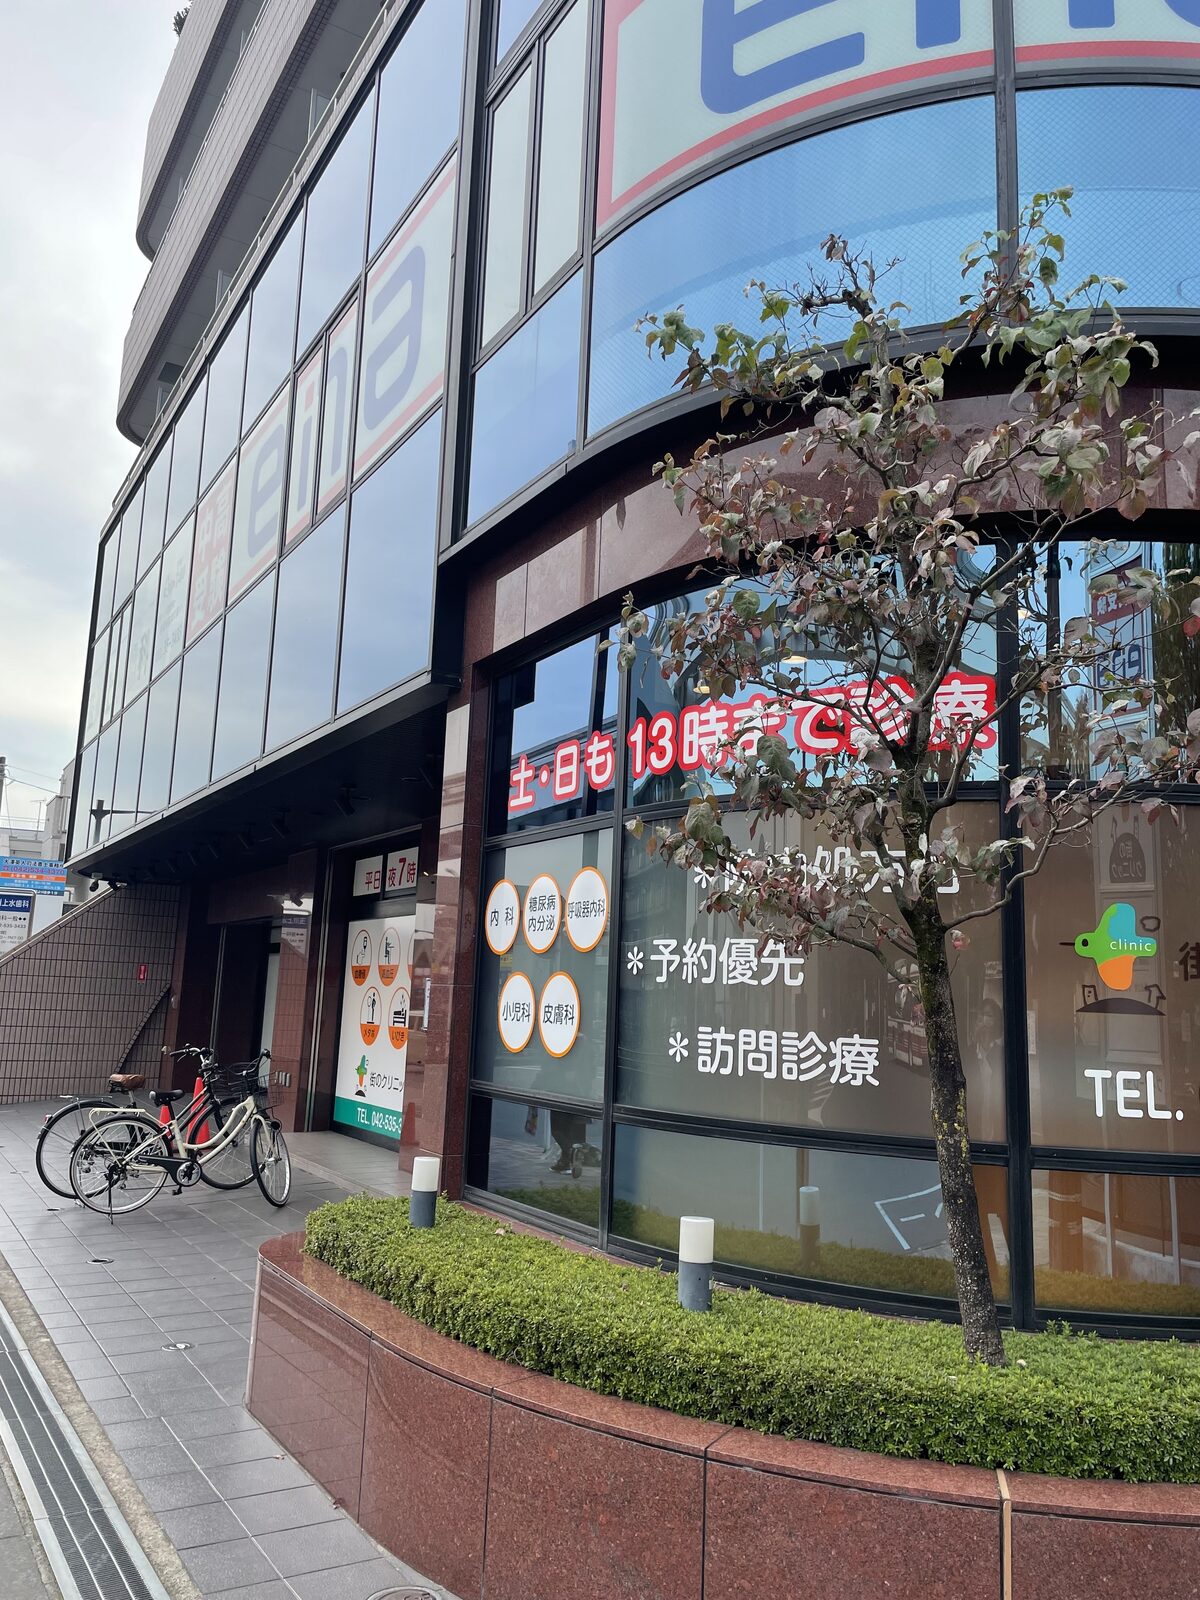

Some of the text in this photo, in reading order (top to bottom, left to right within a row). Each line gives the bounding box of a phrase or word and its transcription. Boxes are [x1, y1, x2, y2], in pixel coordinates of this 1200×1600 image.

[365, 857, 416, 891] 平日 夜7時
[528, 894, 556, 912] 糖尿病
[567, 898, 606, 919] 呼吸器内科
[528, 914, 555, 932] 内分泌
[1109, 938, 1153, 952] clinic
[650, 938, 805, 986] 予約優先
[502, 1002, 531, 1023] 小児科
[542, 1004, 575, 1026] 皮膚科
[697, 1025, 880, 1087] 訪問診療
[1083, 1068, 1184, 1121] TEL.
[357, 1107, 370, 1125] TEL.
